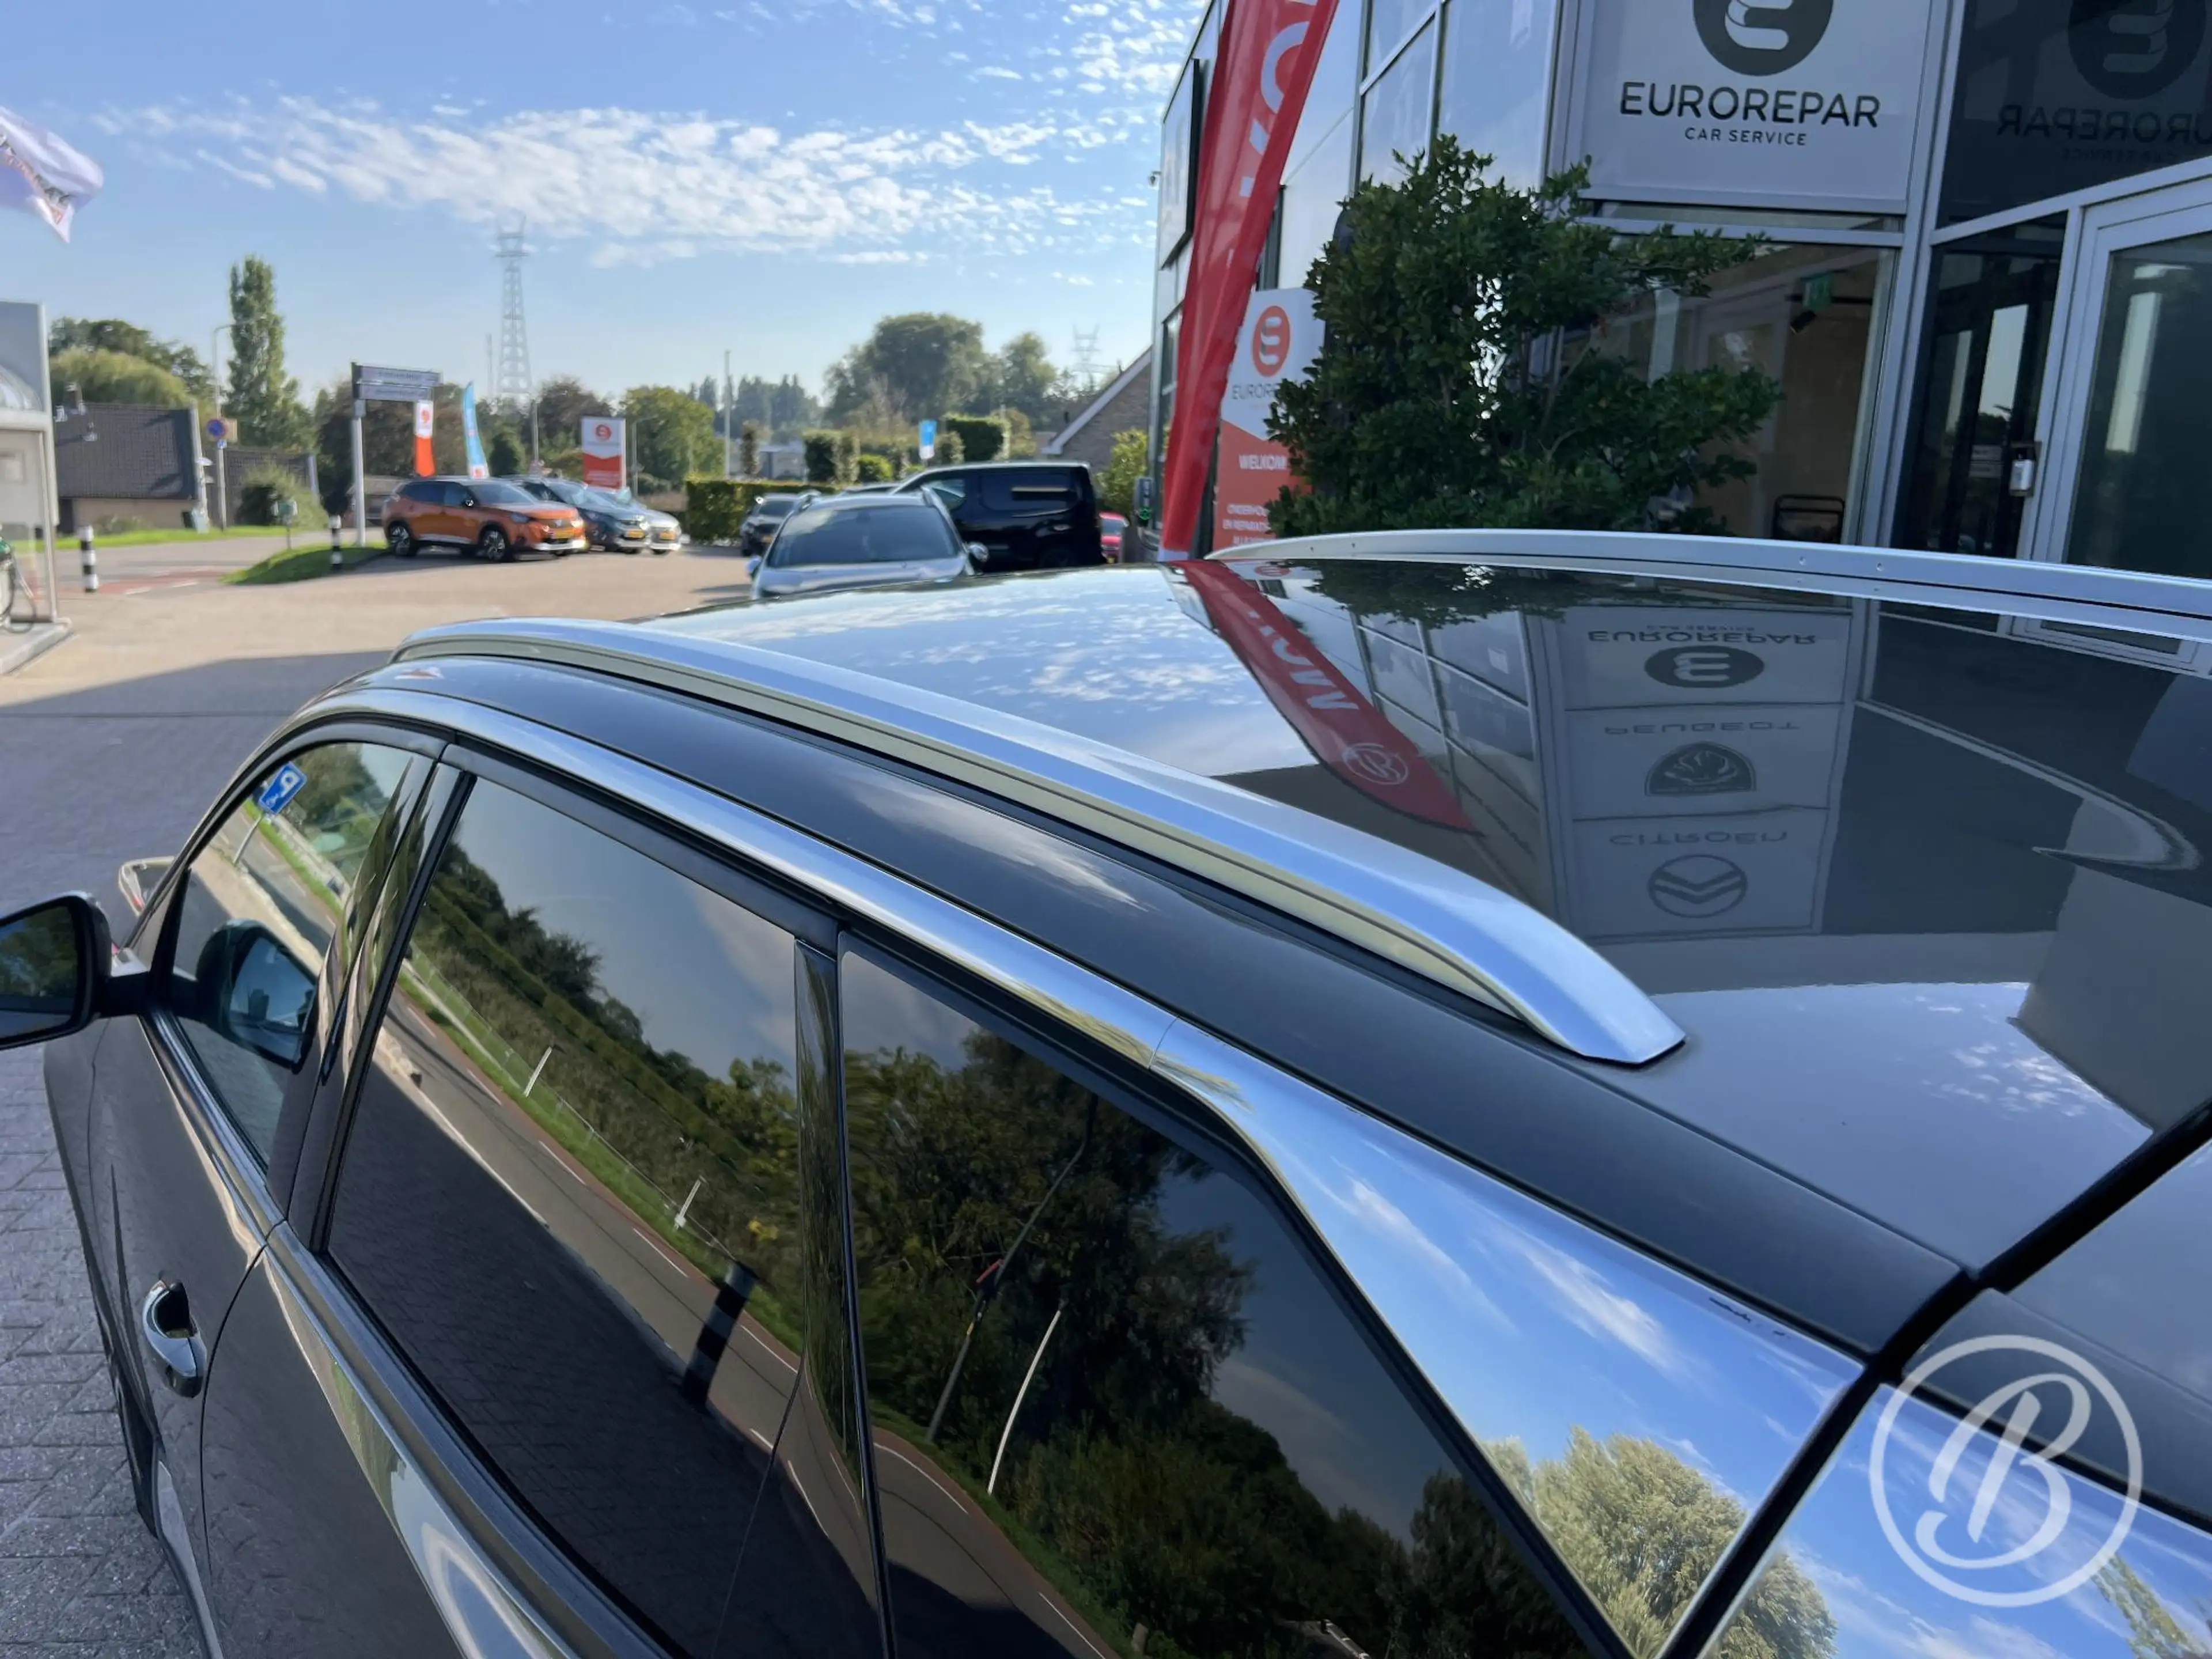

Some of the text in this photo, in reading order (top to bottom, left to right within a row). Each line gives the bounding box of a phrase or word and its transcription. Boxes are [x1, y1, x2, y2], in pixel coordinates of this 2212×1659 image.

[1619, 81, 1881, 128] EUROREPAR
[1684, 127, 1808, 146] CAR SERVICE
